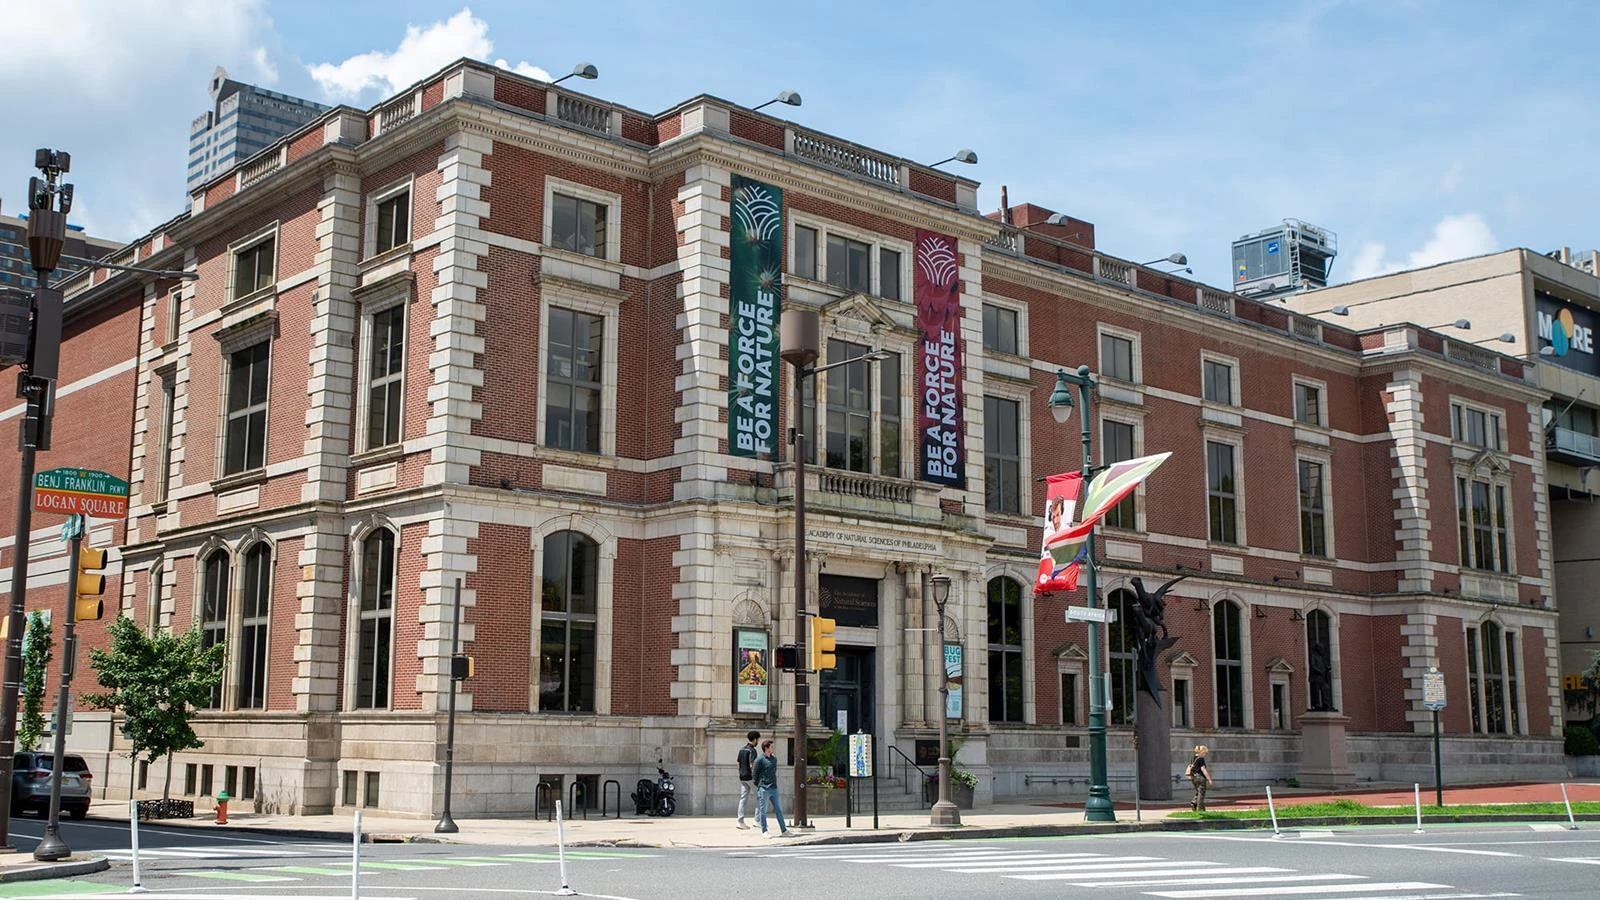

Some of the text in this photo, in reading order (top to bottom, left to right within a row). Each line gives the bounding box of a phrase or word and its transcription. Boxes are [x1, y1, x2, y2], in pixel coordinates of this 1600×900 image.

[736, 300, 756, 451] BE A FORCE
[755, 290, 774, 453] FOR NATURE
[925, 340, 942, 477] BE A FORCE
[940, 330, 958, 479] FOR NATURE
[38, 474, 126, 494] BENJ FRANKLIN PKWY
[36, 494, 124, 514] LOGAN SQUARE
[809, 530, 835, 538] ACADEMY
[844, 533, 868, 543] NATURAL
[868, 536, 893, 546] SCIENCES
[902, 540, 937, 551] PHILADELPHIA
[944, 646, 960, 655] BUG
[944, 655, 960, 663] FEST
